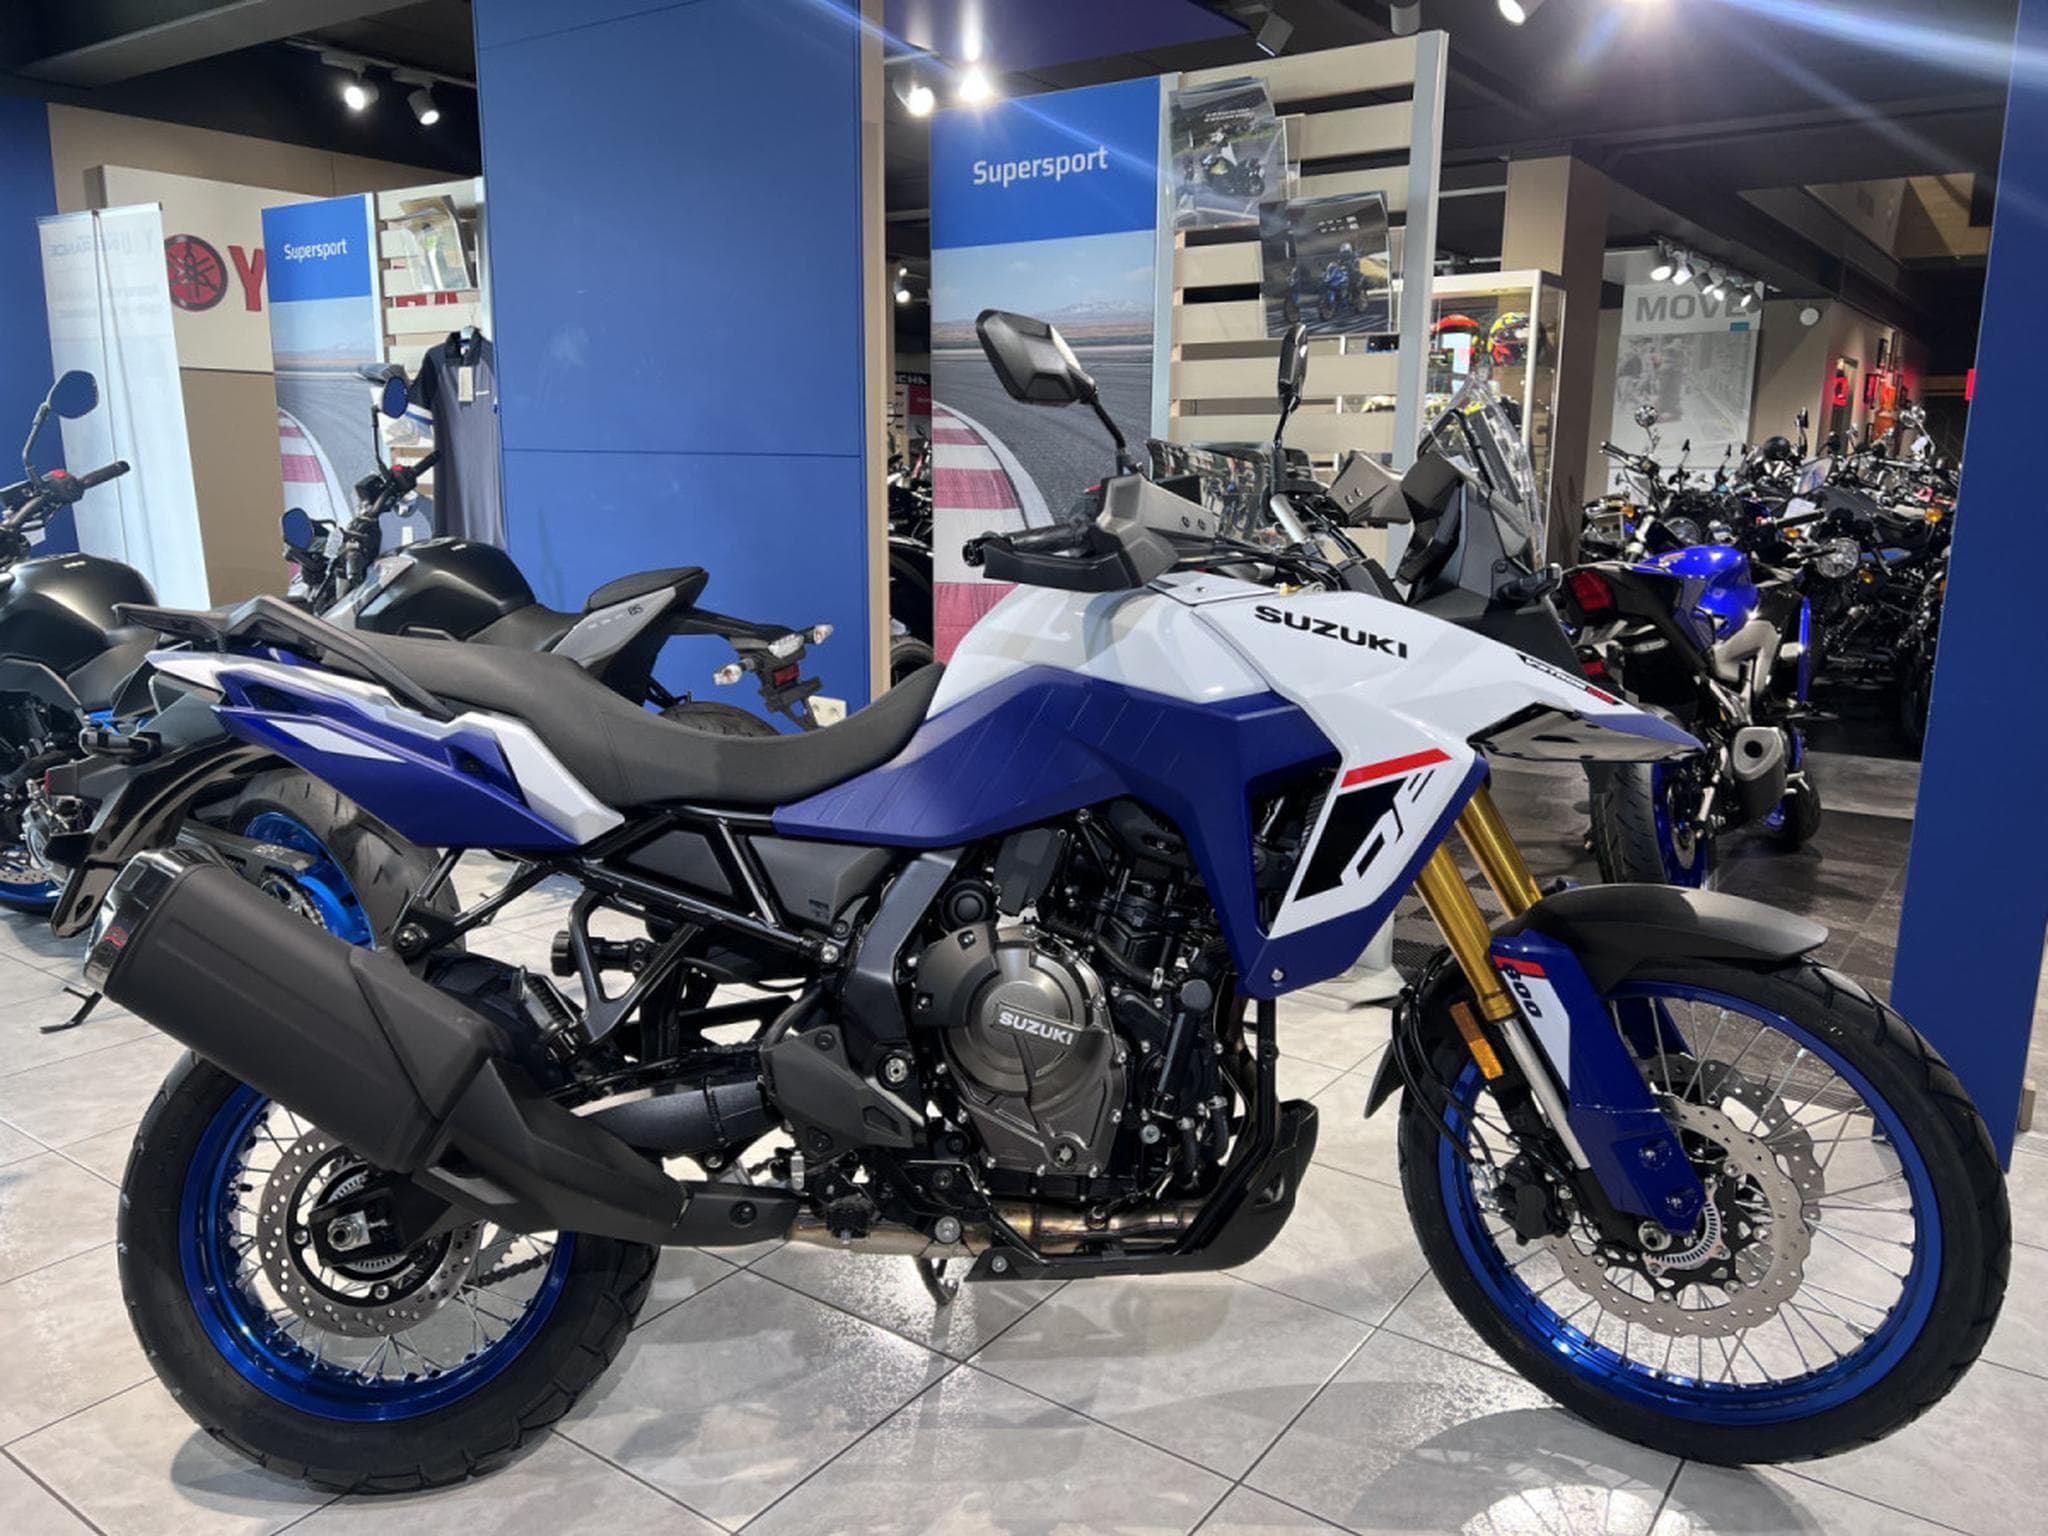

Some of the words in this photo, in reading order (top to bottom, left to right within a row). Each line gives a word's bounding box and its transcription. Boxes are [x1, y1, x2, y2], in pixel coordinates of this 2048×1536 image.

[973, 145, 1108, 188] Supersport
[283, 238, 348, 264] Supersport
[1254, 604, 1408, 660] SUZUKI
[1501, 964, 1543, 1018] 800
[999, 1010, 1074, 1046] SUZUKI
